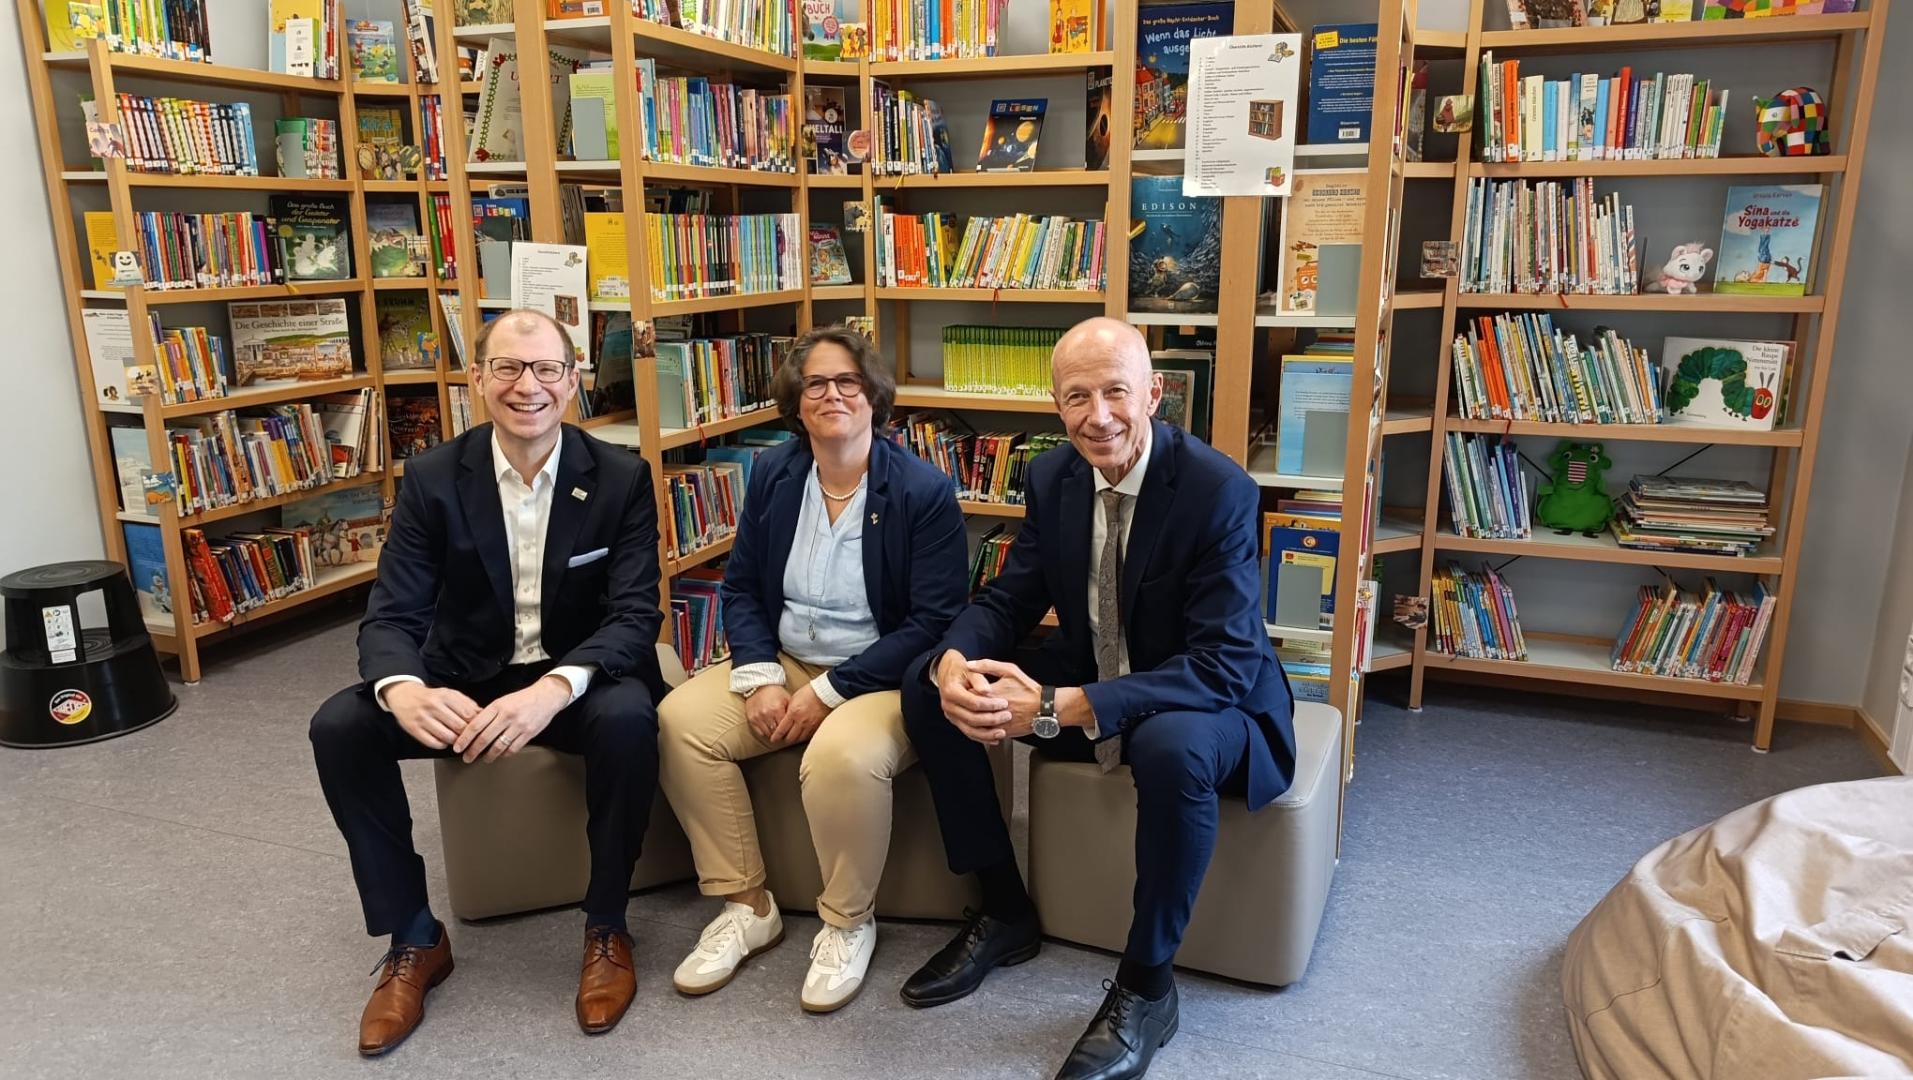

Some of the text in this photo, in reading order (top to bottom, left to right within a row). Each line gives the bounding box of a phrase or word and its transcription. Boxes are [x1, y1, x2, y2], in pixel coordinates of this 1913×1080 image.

[807, 3, 830, 14] BUCH
[1145, 27, 1217, 44] Wenn das Licht
[1163, 44, 1190, 56] ausge
[1009, 103, 1039, 112] LESEN
[489, 207, 517, 216] LESEN
[1141, 202, 1197, 211] EDISON
[1744, 204, 1769, 216] Sina
[1738, 215, 1800, 230] Yogakatze
[235, 320, 249, 330] Die
[251, 318, 297, 329] Geschichte
[298, 317, 318, 327] einer
